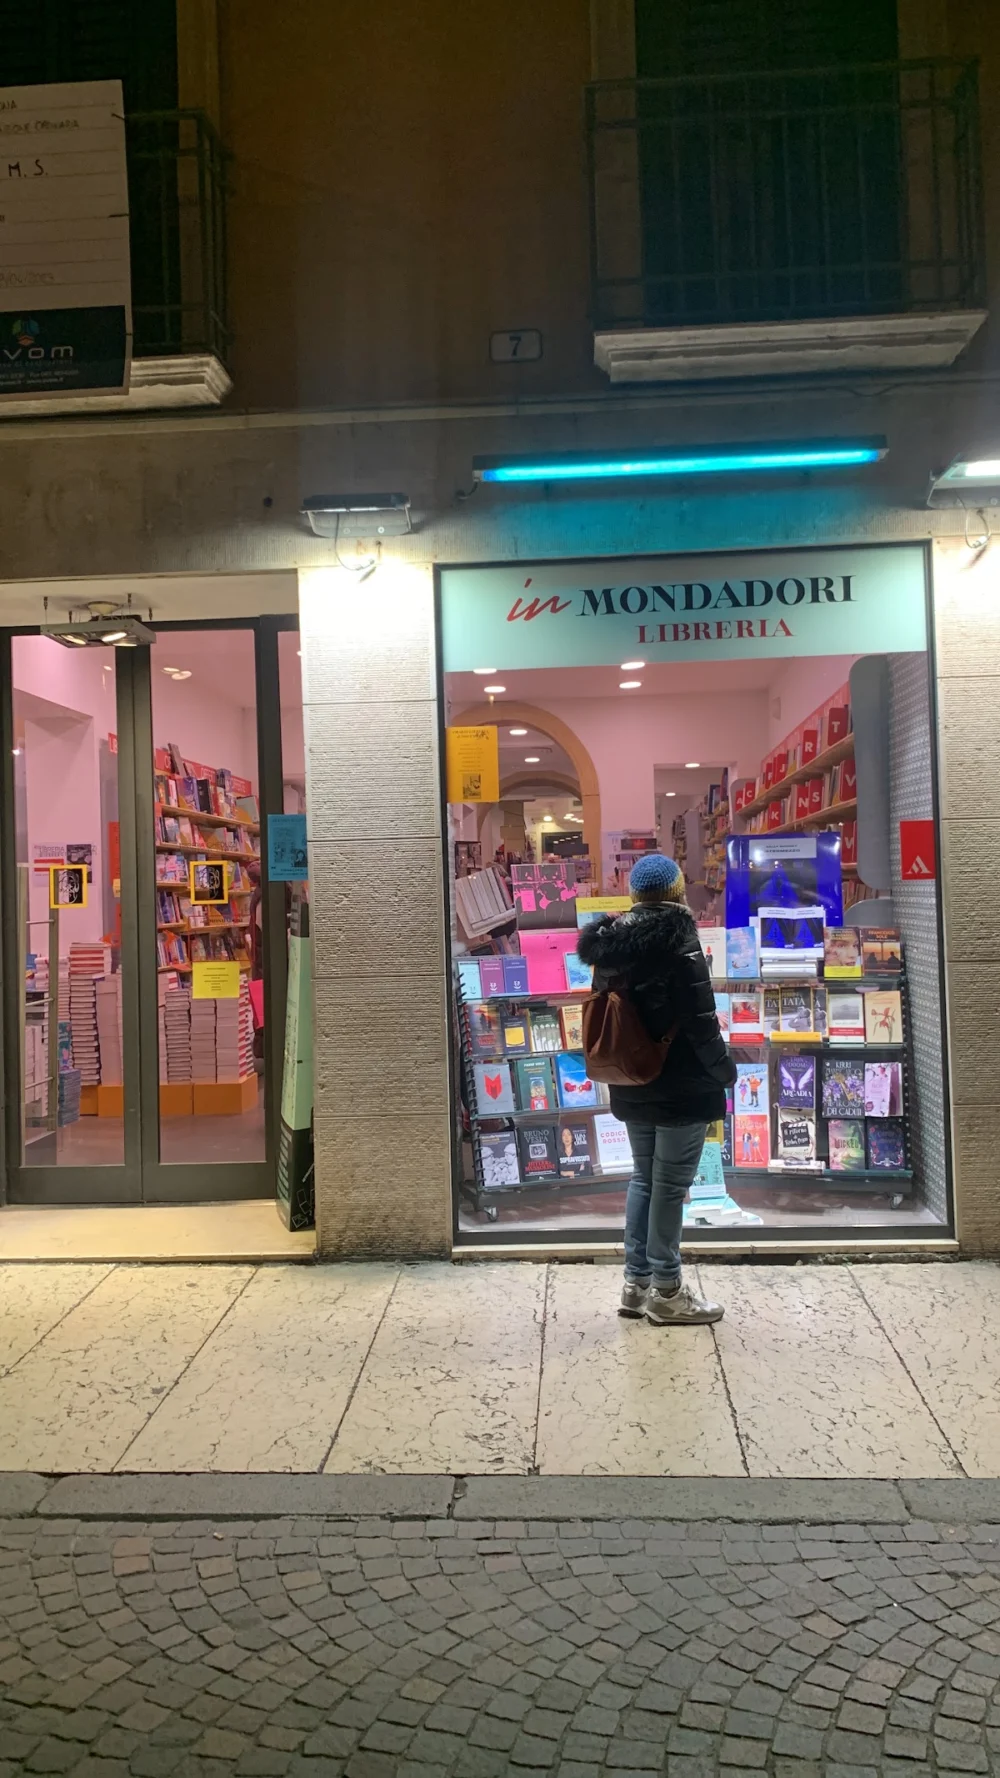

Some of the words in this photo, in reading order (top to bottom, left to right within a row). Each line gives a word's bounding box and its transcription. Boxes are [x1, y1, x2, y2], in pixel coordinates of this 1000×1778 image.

[509, 336, 521, 356] 7
[507, 578, 572, 622] in
[575, 574, 858, 618] MONDADORI
[637, 618, 797, 643] LIBRERIA
[832, 721, 840, 733] T
[805, 742, 813, 752] R
[746, 790, 753, 798] C
[812, 792, 820, 802] S
[798, 798, 809, 808] N
[771, 811, 779, 820] K
[524, 1130, 549, 1138] BRUNO
